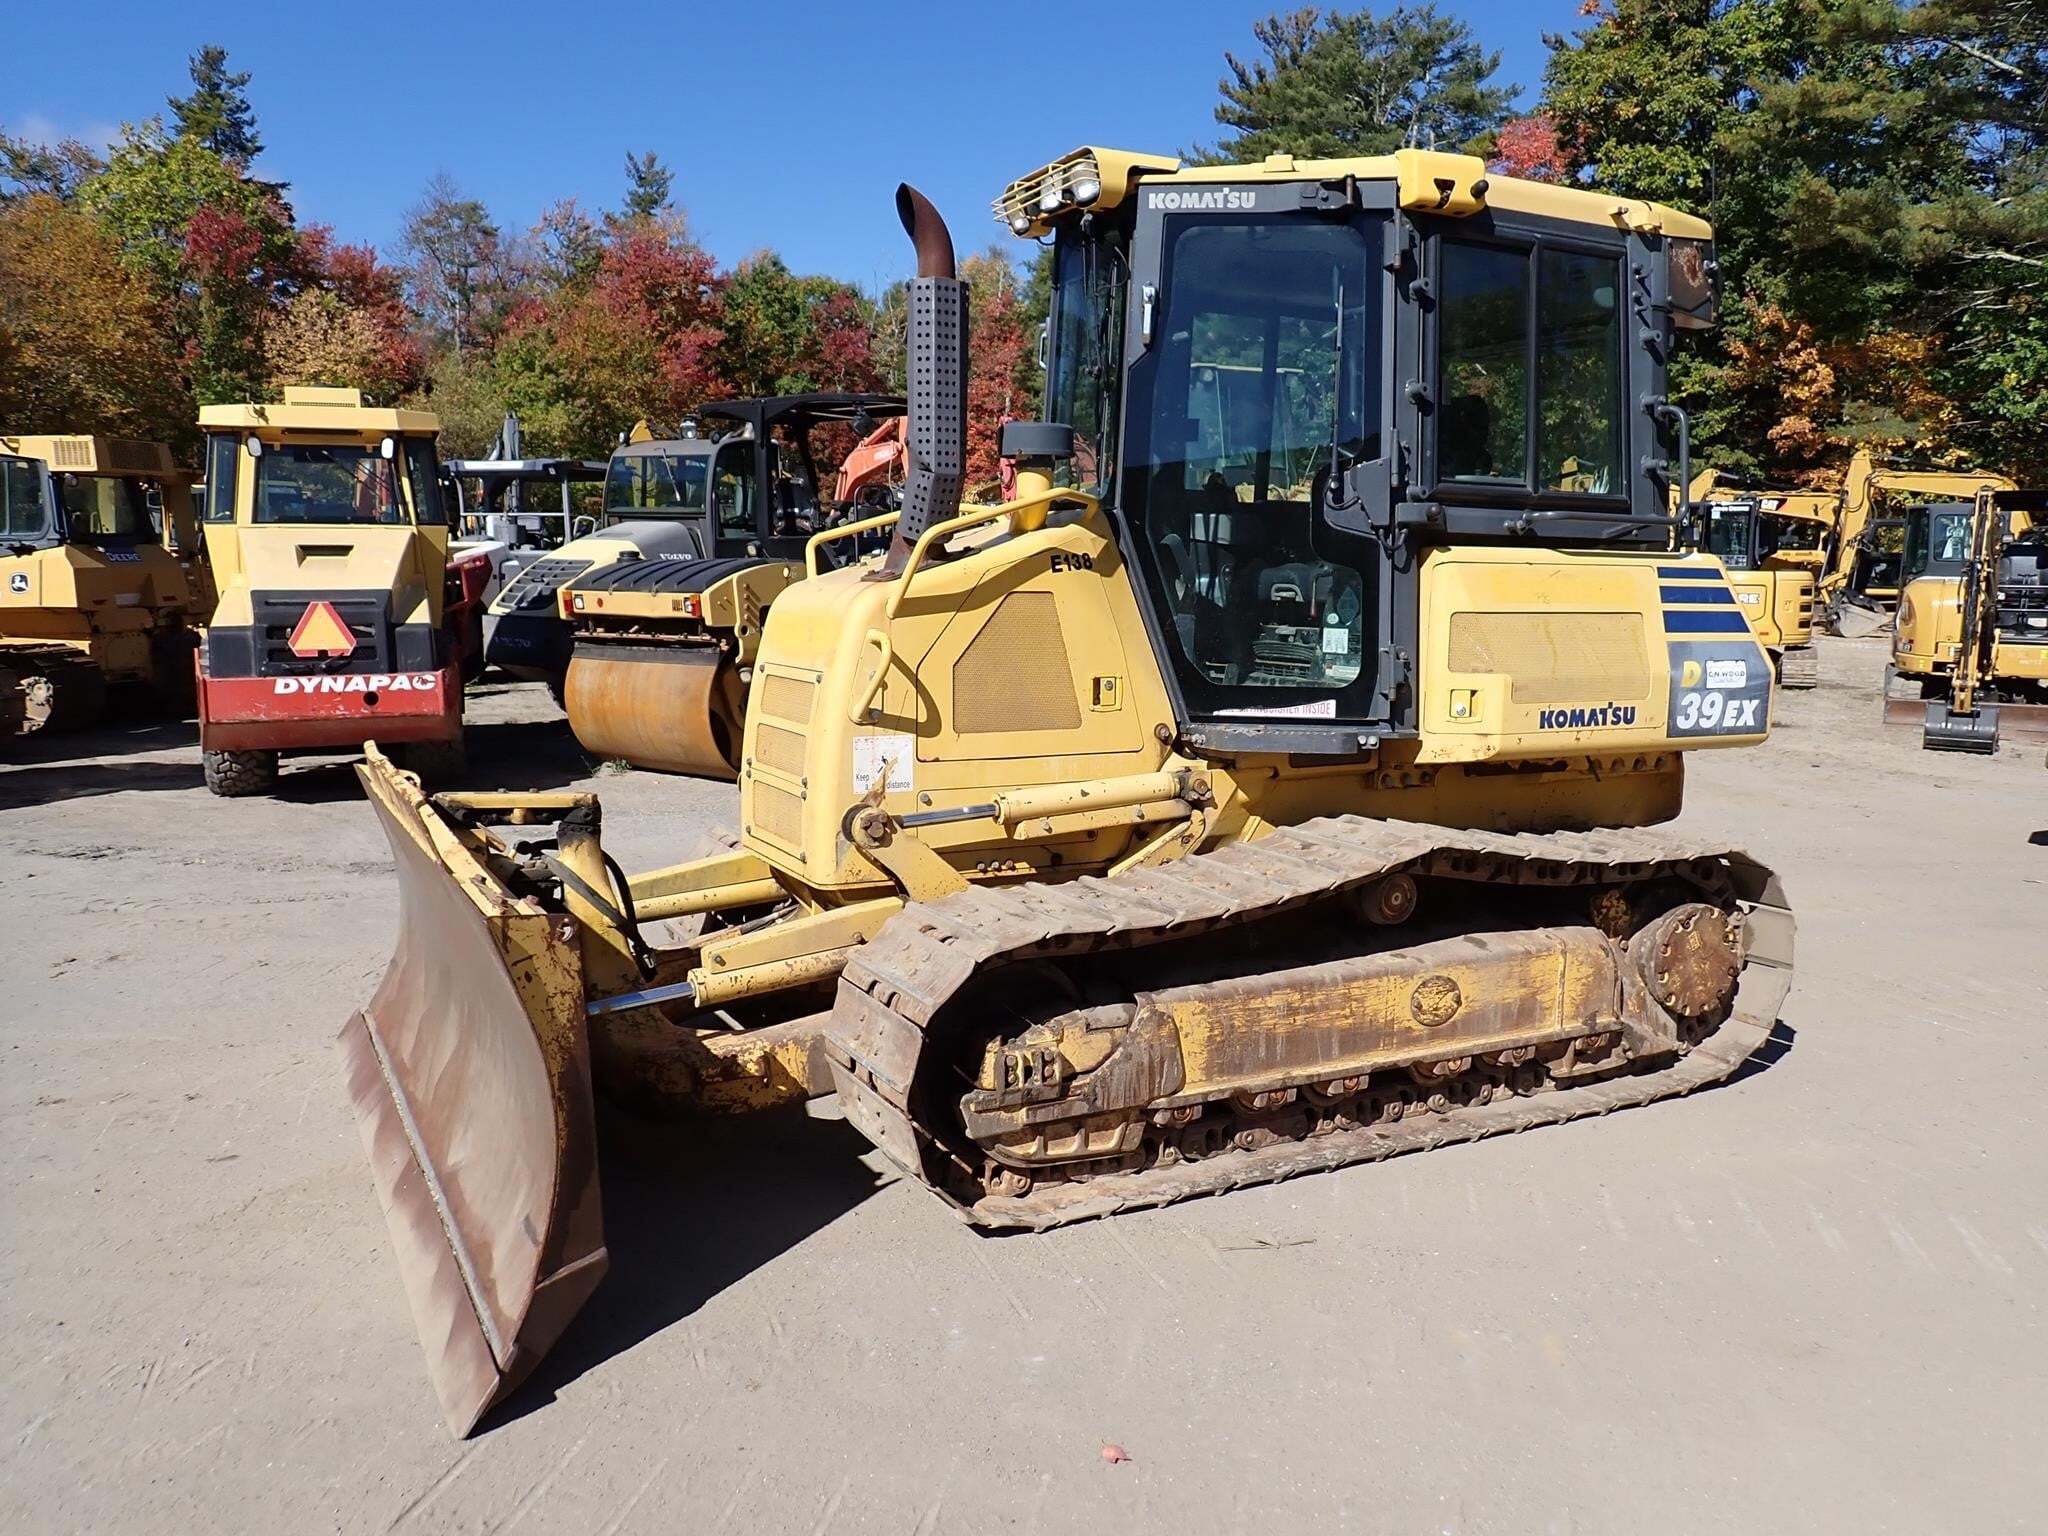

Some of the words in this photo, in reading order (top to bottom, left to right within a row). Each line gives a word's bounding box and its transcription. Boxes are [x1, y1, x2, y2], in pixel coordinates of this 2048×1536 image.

[1148, 187, 1256, 209] KOMATSU
[1050, 552, 1093, 573] E138
[273, 674, 436, 695] DYNAPAC
[1680, 660, 1701, 688] D
[1302, 702, 1331, 715] INSIDE
[1539, 701, 1636, 729] KOMATSU
[855, 773, 870, 782] Keep
[886, 781, 911, 790] distance
